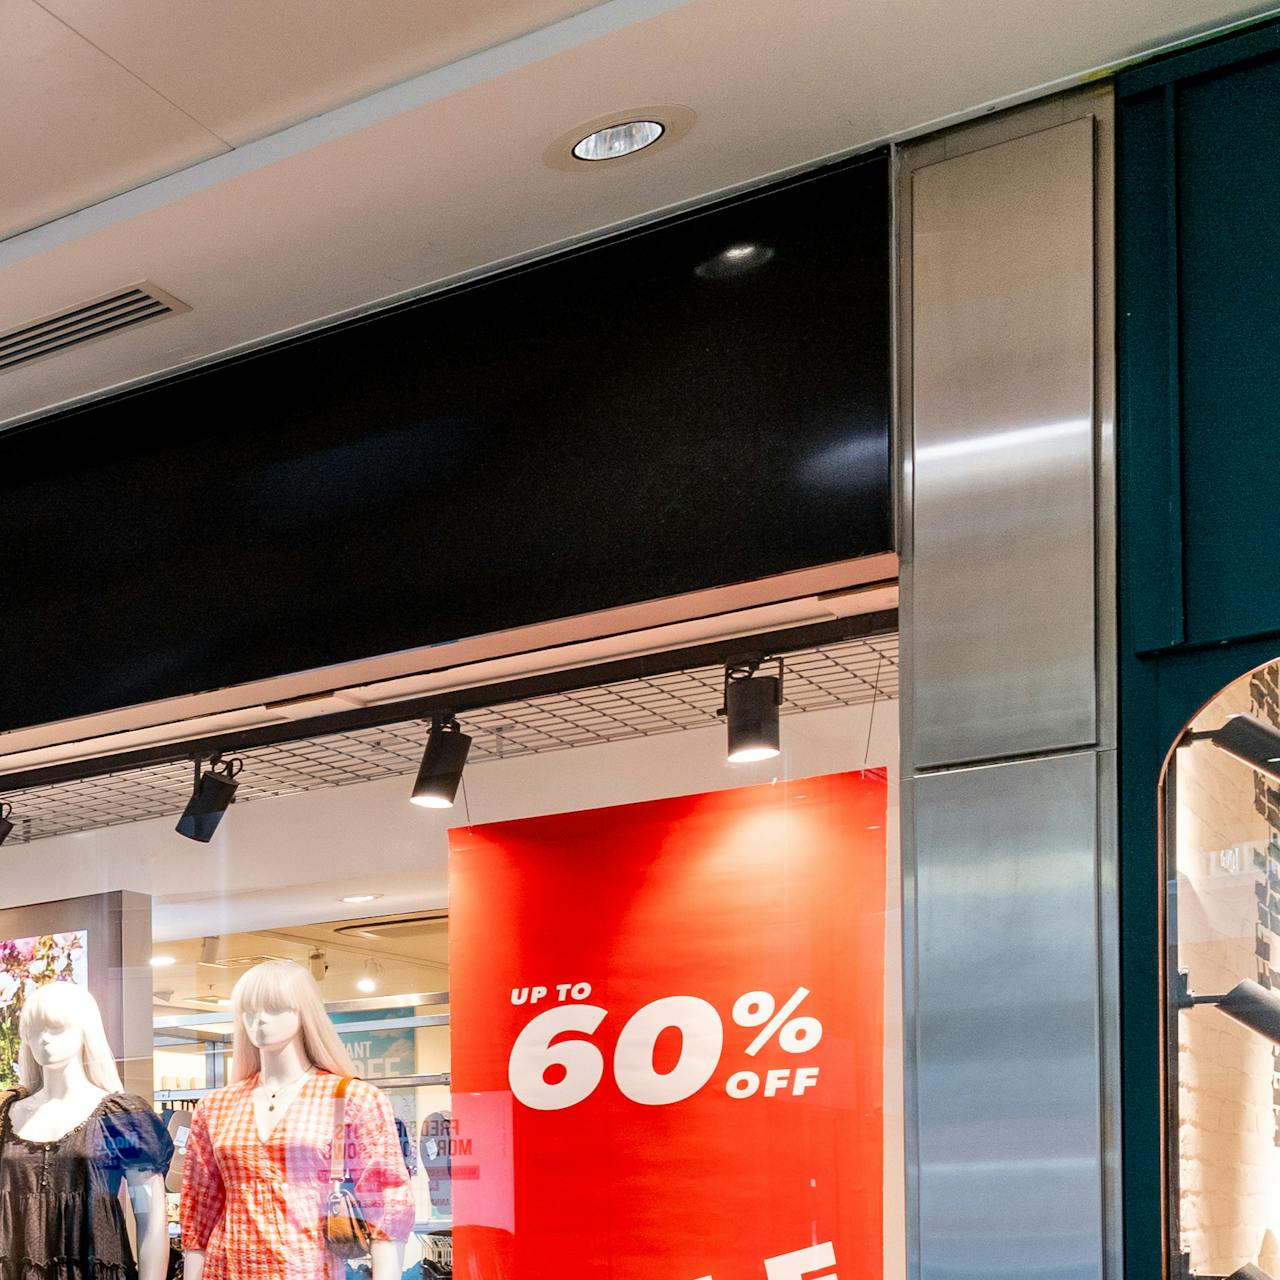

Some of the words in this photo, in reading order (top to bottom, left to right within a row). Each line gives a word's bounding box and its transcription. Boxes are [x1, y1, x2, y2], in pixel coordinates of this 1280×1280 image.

[510, 985, 548, 1006] UP
[556, 981, 592, 1002] TO
[344, 1041, 373, 1059] ANT
[508, 986, 824, 1111] 60%
[725, 1066, 820, 1099] OFF
